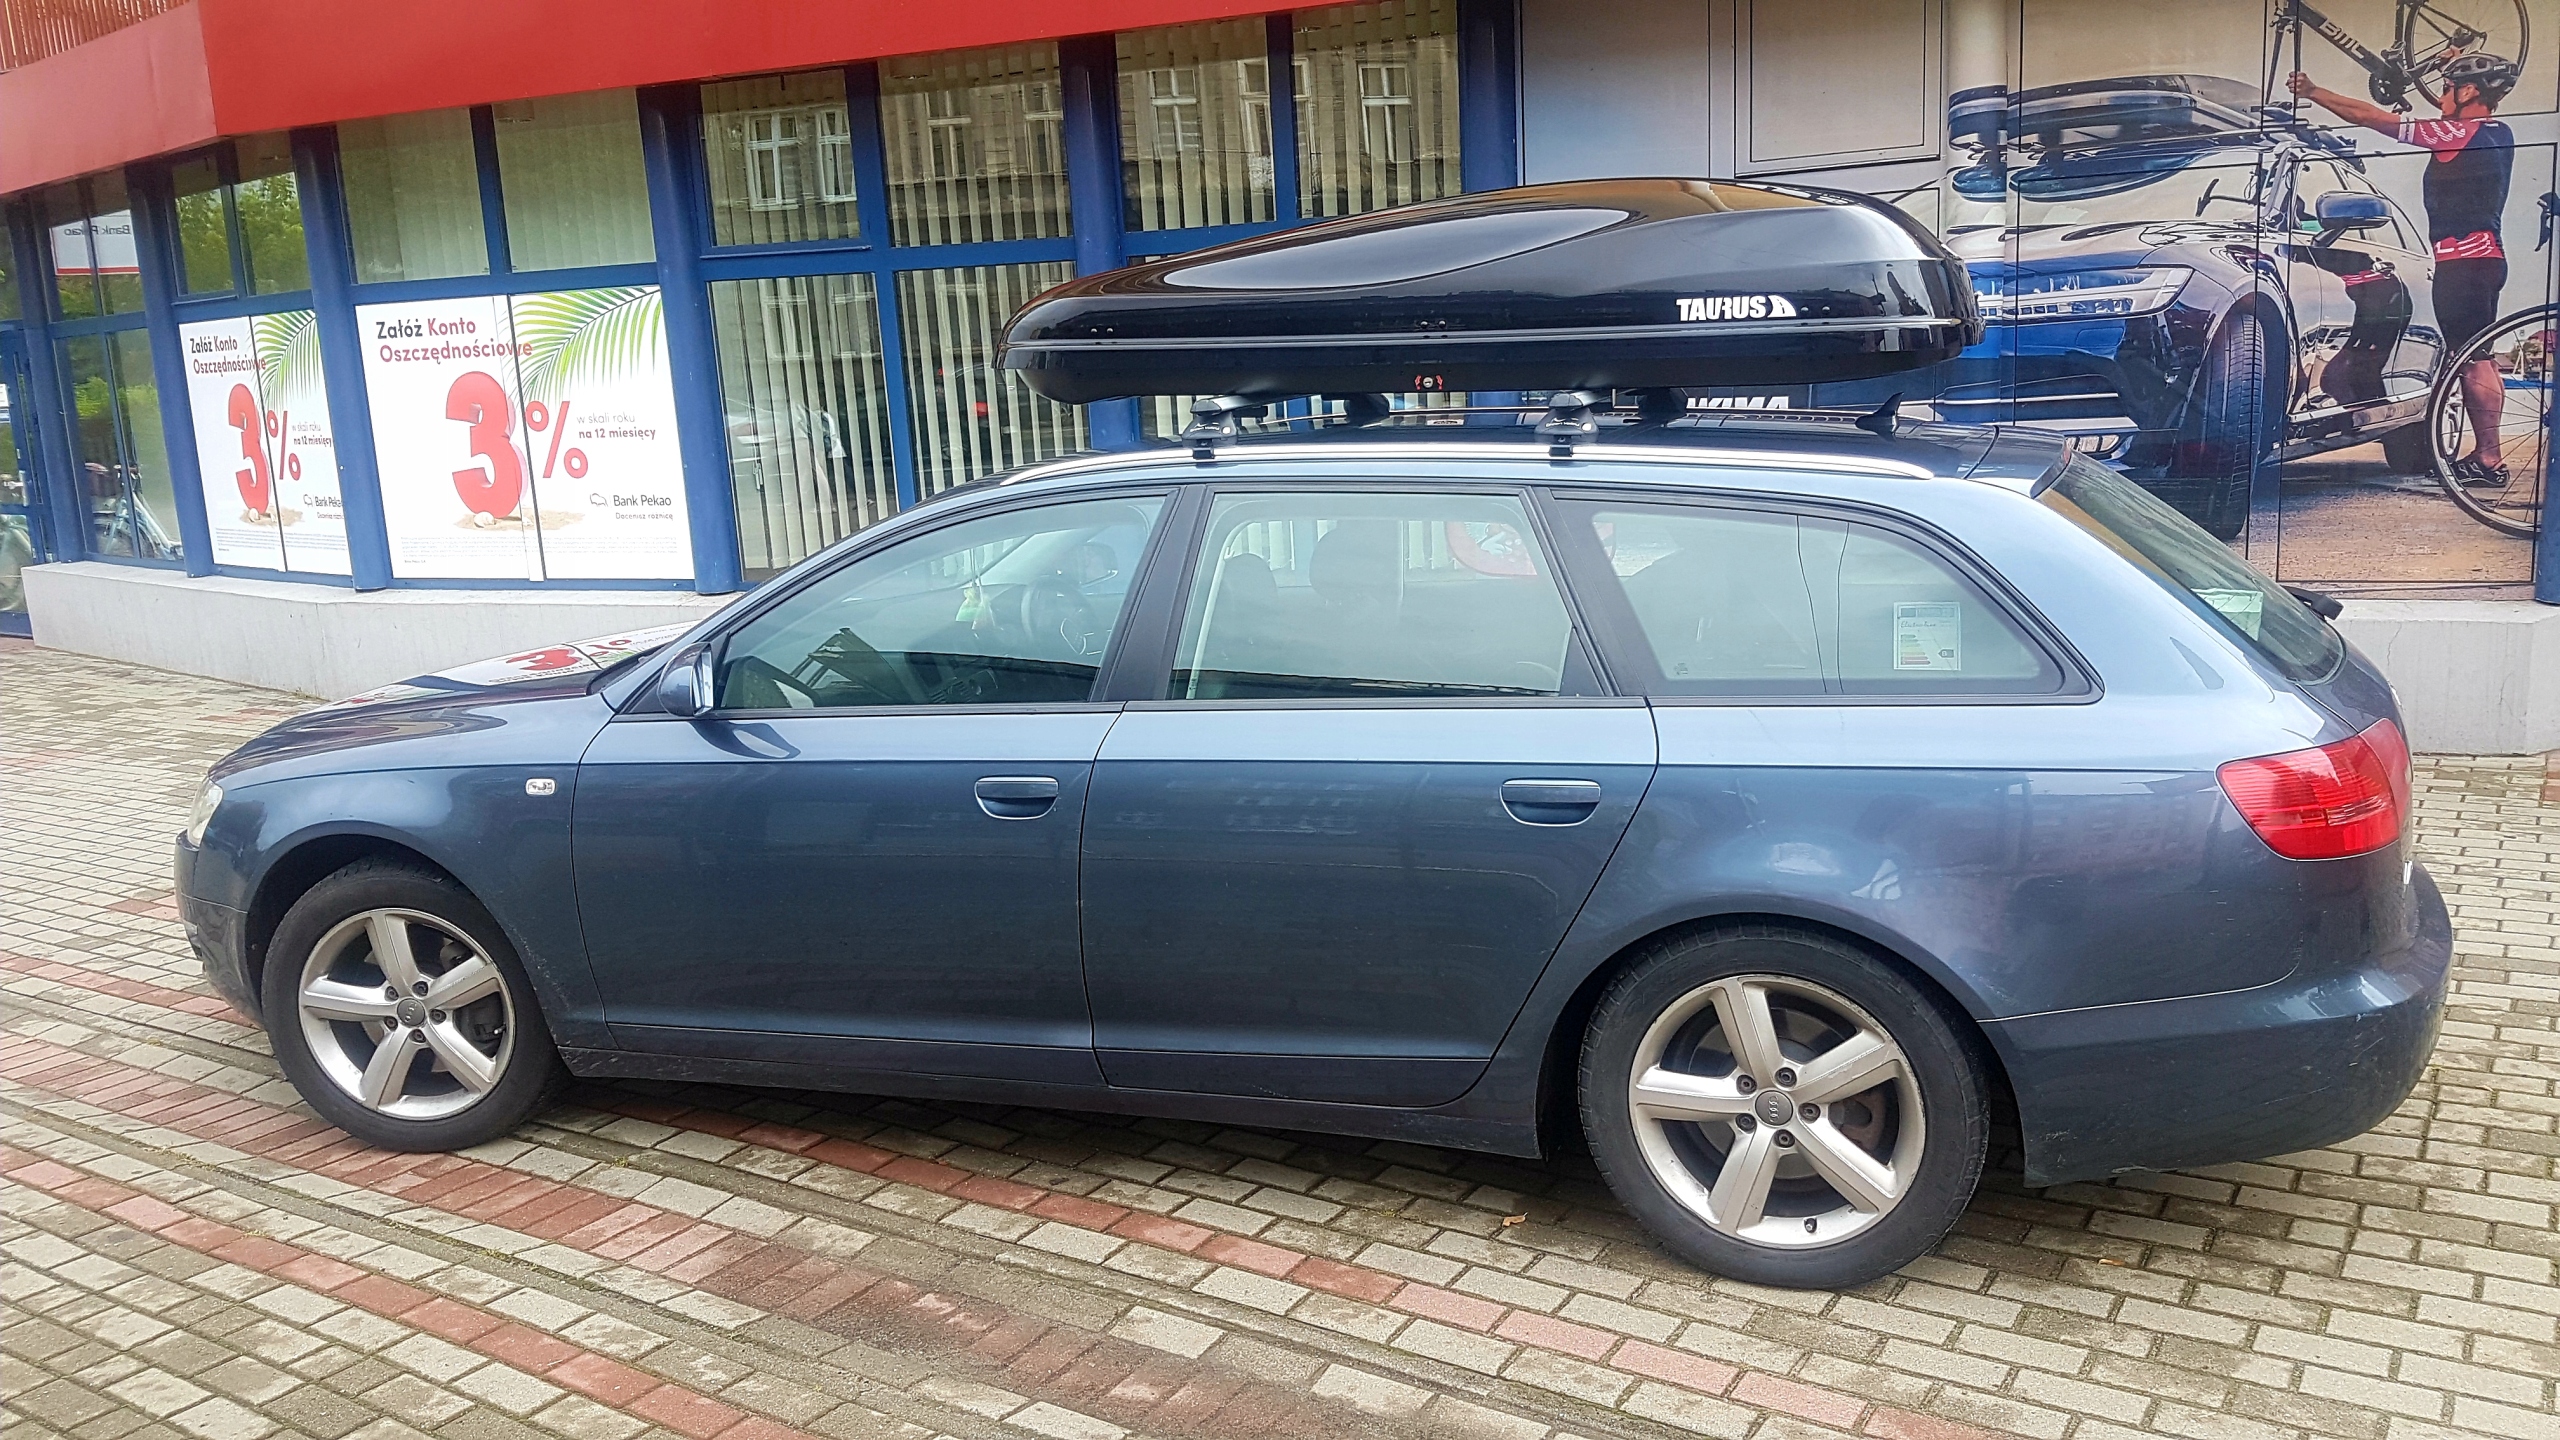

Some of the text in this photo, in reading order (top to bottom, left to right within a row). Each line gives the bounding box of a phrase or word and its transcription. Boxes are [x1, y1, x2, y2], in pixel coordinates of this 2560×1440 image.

[1676, 295, 1767, 321] TAURUS
[376, 317, 476, 340] Załóż Konto
[190, 334, 238, 354] Załóż Konto
[380, 338, 533, 365] Oszczędnościowe
[576, 411, 636, 424] w skali roku
[579, 426, 656, 440] na 12 miesięcy
[293, 434, 332, 448] na 12 miesięcy
[315, 496, 329, 507] Bank
[613, 494, 672, 506] Bank Pekao
